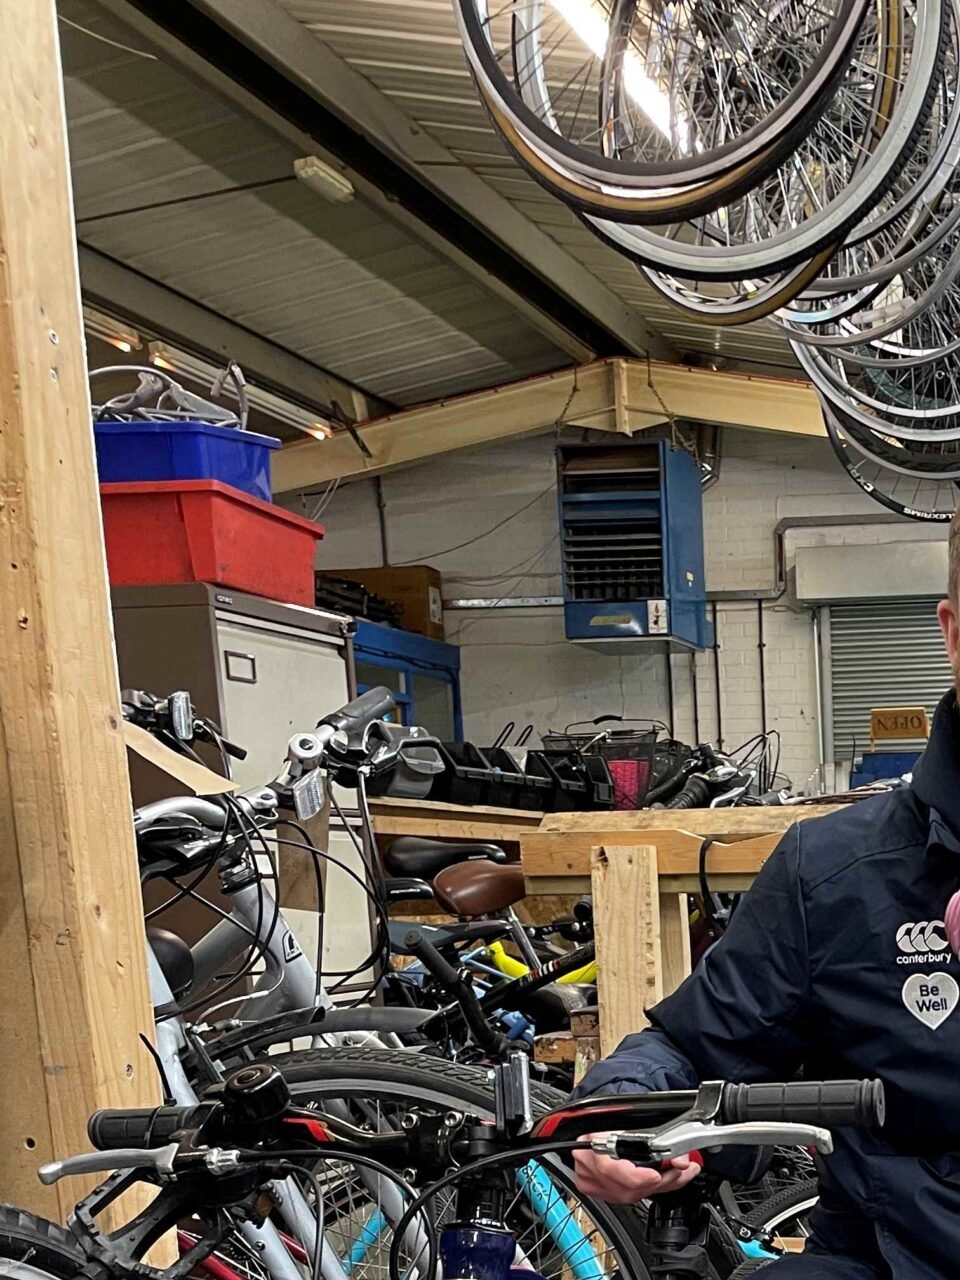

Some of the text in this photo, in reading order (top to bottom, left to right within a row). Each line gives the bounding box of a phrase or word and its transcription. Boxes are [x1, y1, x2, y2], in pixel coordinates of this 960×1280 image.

[896, 952, 952, 965] canterbury
[919, 984, 940, 997] Be
[915, 998, 948, 1013] Well
